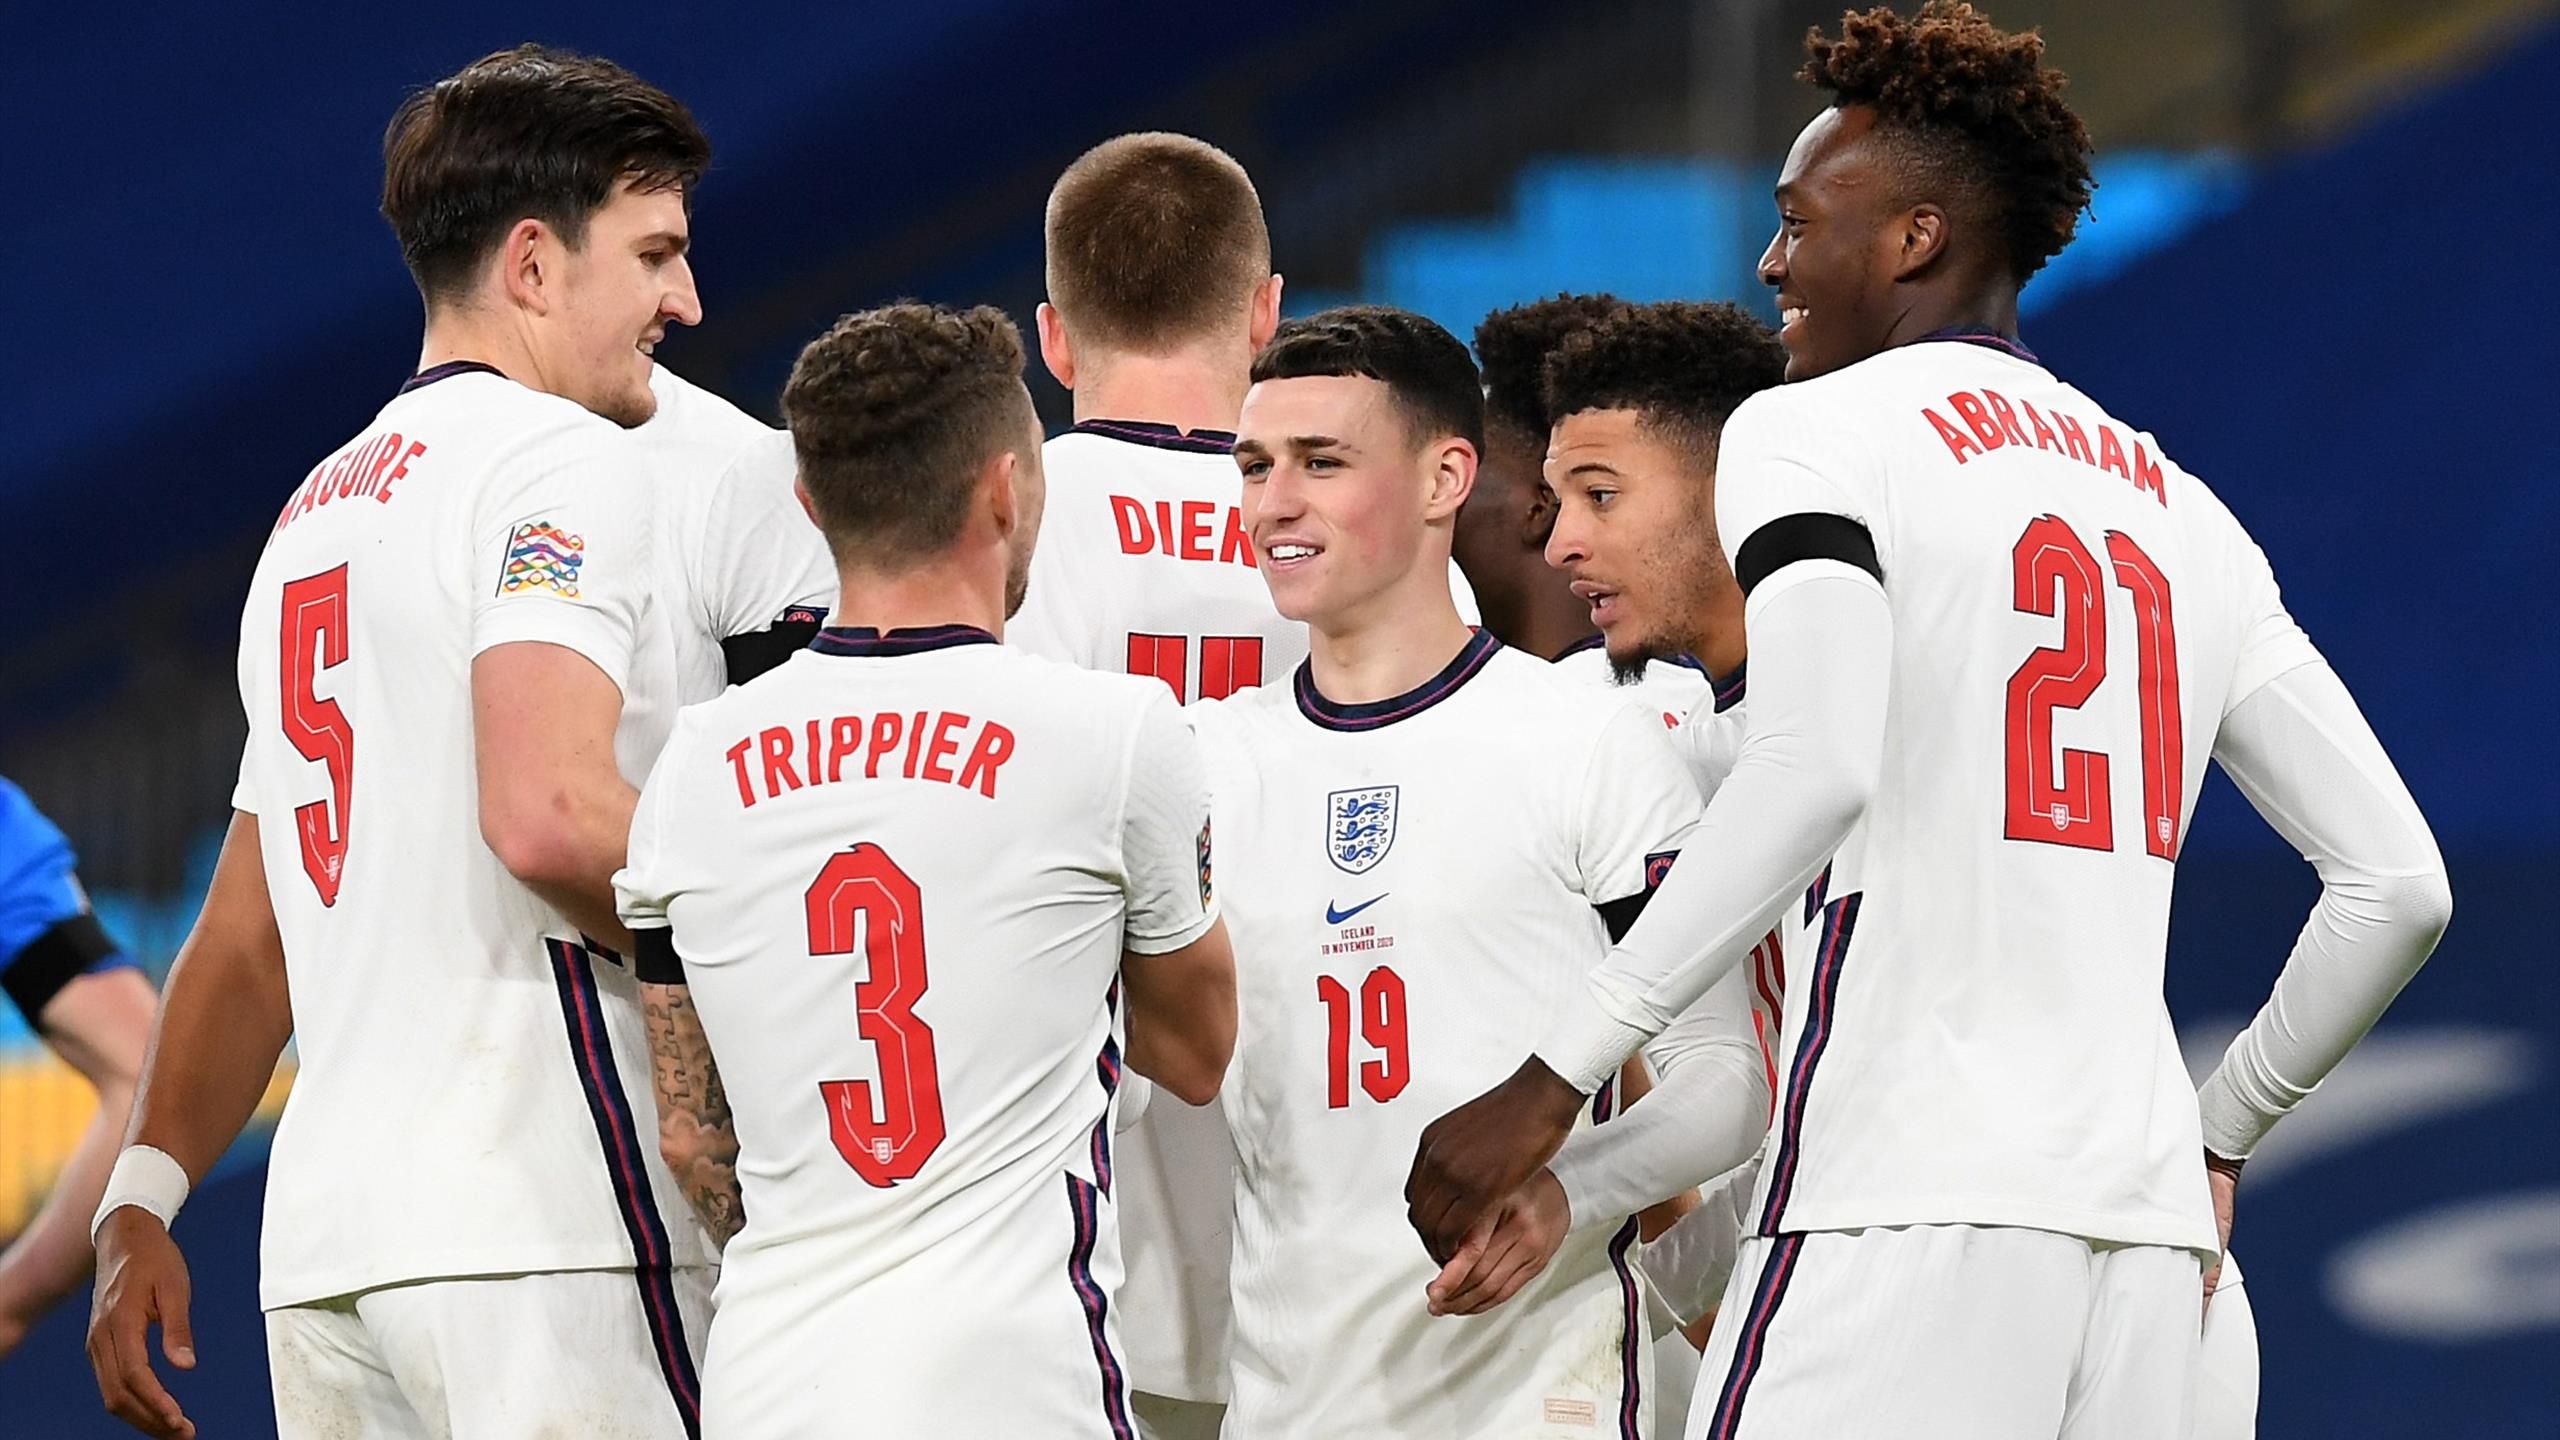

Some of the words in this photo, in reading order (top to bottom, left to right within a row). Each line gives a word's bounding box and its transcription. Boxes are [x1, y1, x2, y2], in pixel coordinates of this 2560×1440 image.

[1920, 388, 2168, 509] ABRAHAM
[280, 561, 354, 908] 5
[2004, 513, 2184, 863] 21
[726, 711, 1016, 809] TRIPPIER
[1332, 939, 1375, 954] NOVEMBER
[1340, 926, 1376, 940] ICELAND
[804, 842, 947, 1189] 3
[1317, 965, 1411, 1110] 19
